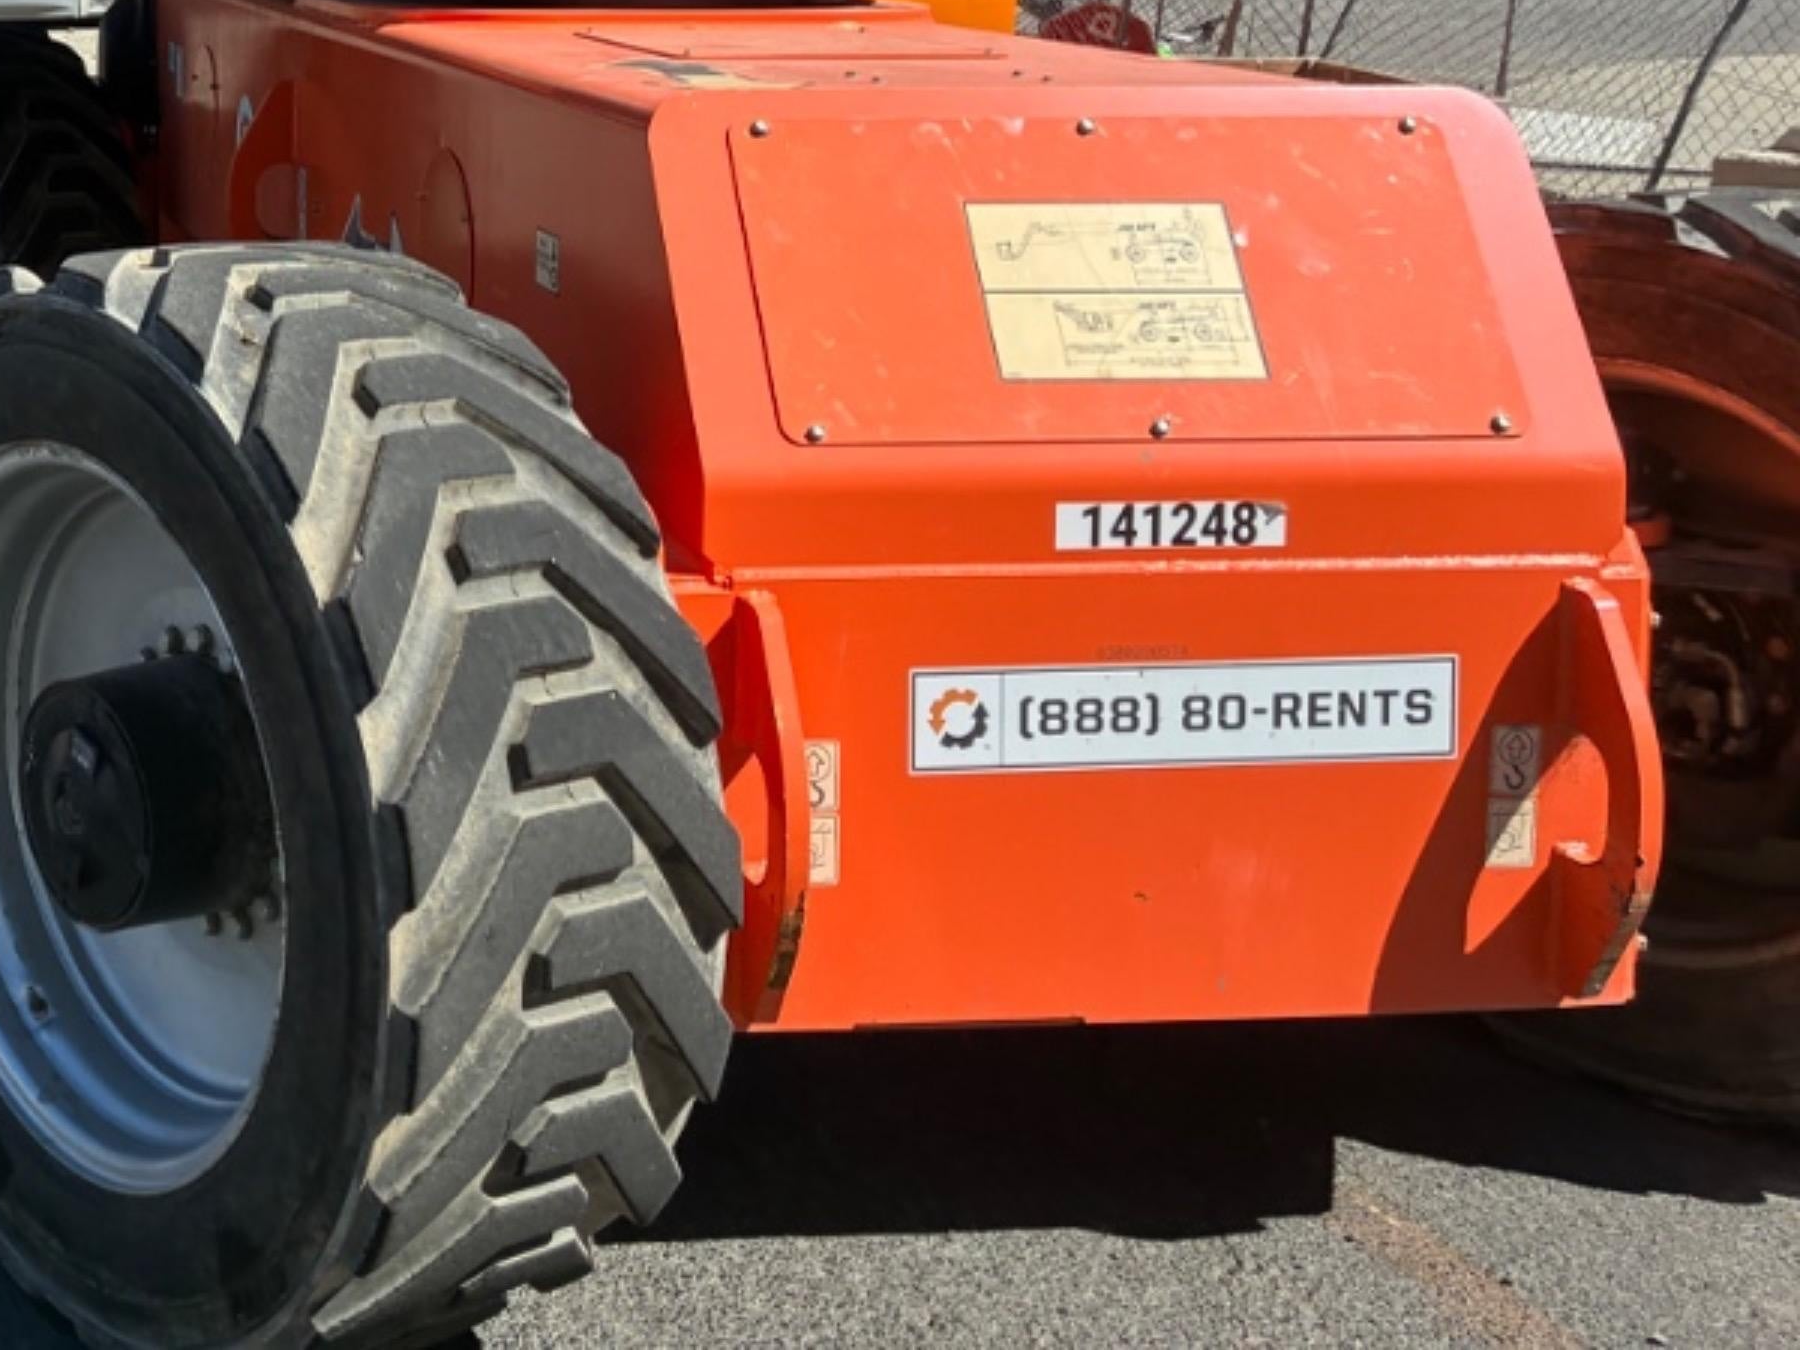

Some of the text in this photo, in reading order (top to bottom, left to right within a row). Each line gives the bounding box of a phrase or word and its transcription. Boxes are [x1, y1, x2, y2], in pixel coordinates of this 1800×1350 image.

[1082, 500, 1257, 548] 141248
[1018, 688, 1434, 738] (888) 80-RENTS
